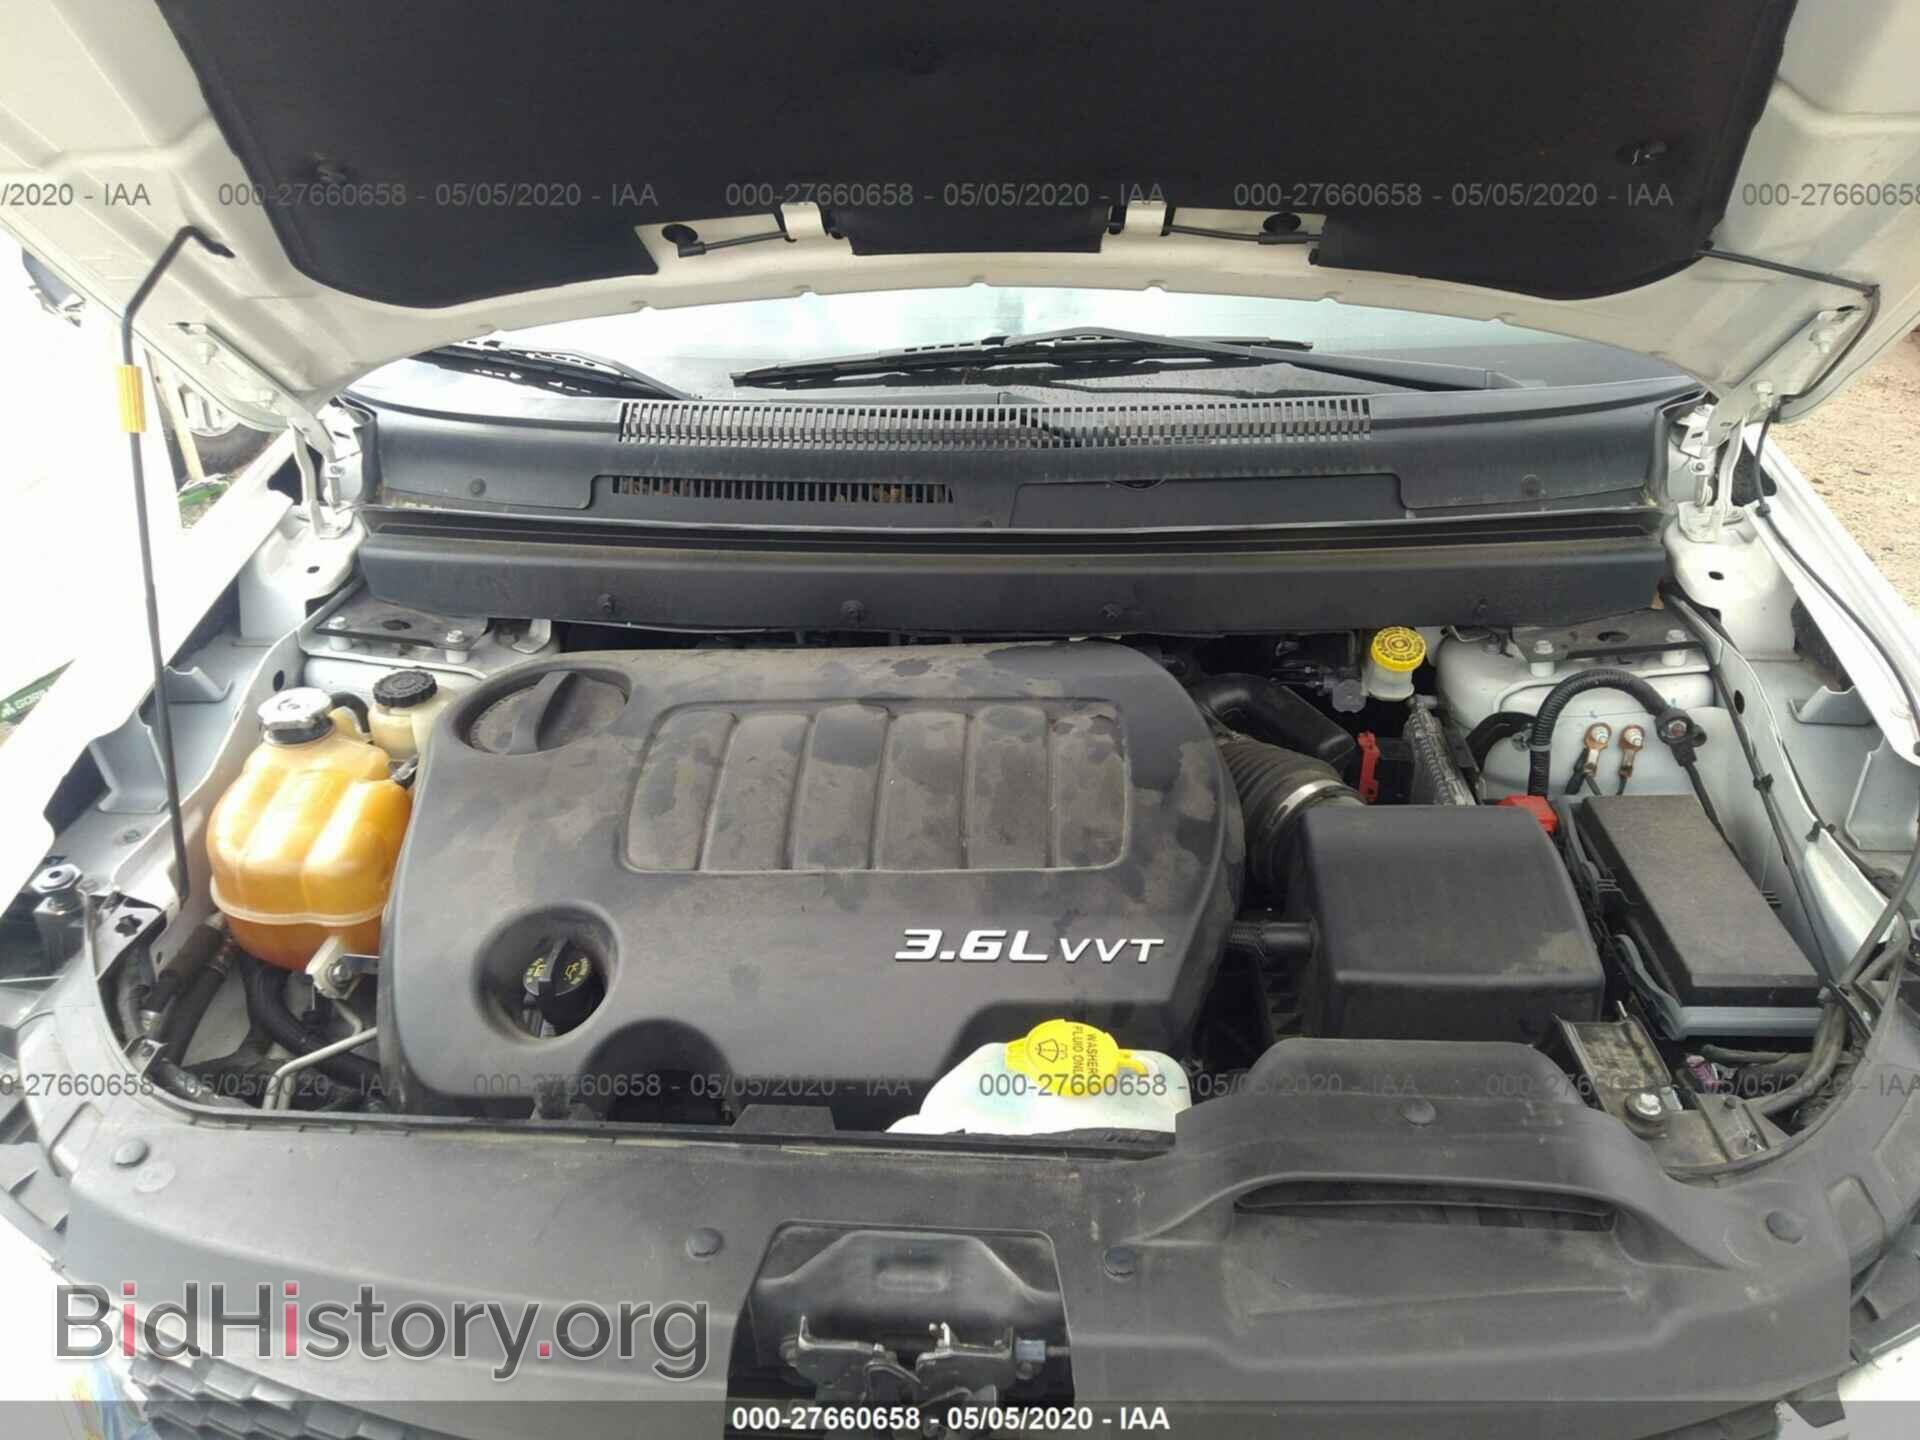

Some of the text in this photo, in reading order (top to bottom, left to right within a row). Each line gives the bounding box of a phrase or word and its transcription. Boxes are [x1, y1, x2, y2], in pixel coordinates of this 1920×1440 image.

[894, 928, 1165, 963] 3.6L VVT
[1072, 1055, 1084, 1075] ONL
[1087, 1033, 1099, 1074] WASHER
